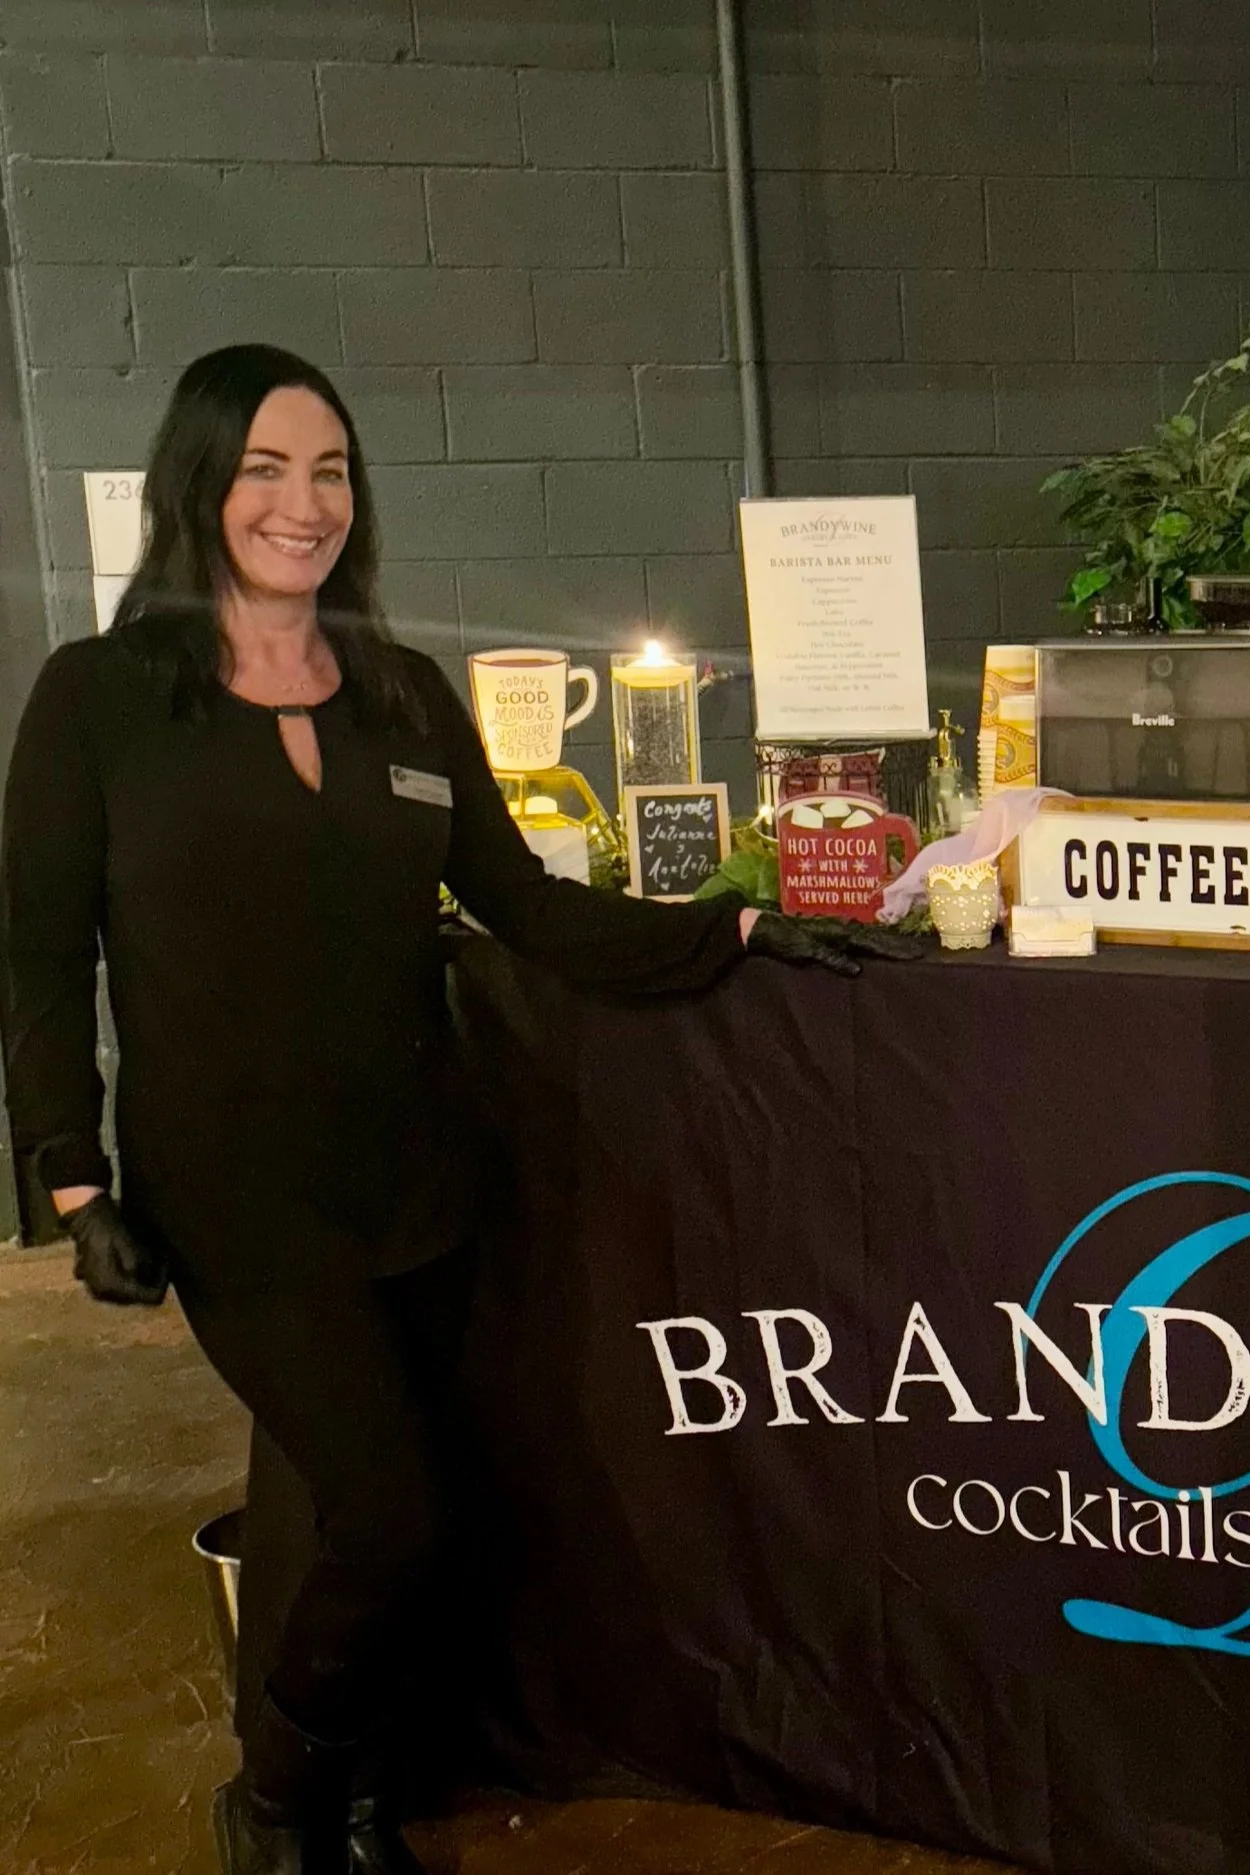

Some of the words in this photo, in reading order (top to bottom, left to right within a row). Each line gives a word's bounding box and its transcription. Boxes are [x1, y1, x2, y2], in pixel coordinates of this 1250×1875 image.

[780, 519, 877, 538] BRANDYWINE
[769, 556, 823, 568] BARISTA
[826, 556, 852, 567] BAR
[856, 554, 892, 566] MENU
[496, 690, 549, 705] GOOD
[495, 706, 534, 721] MOOD
[1132, 713, 1175, 727] Breville
[497, 741, 553, 760] COFFEE
[787, 838, 818, 855] HOT
[825, 839, 877, 856] COCOA
[819, 859, 848, 872] WITH
[1064, 838, 1249, 906] COFFEE
[787, 875, 881, 889] MARSHMALLOWS
[799, 891, 840, 905] SERVED
[843, 891, 870, 905] HERE
